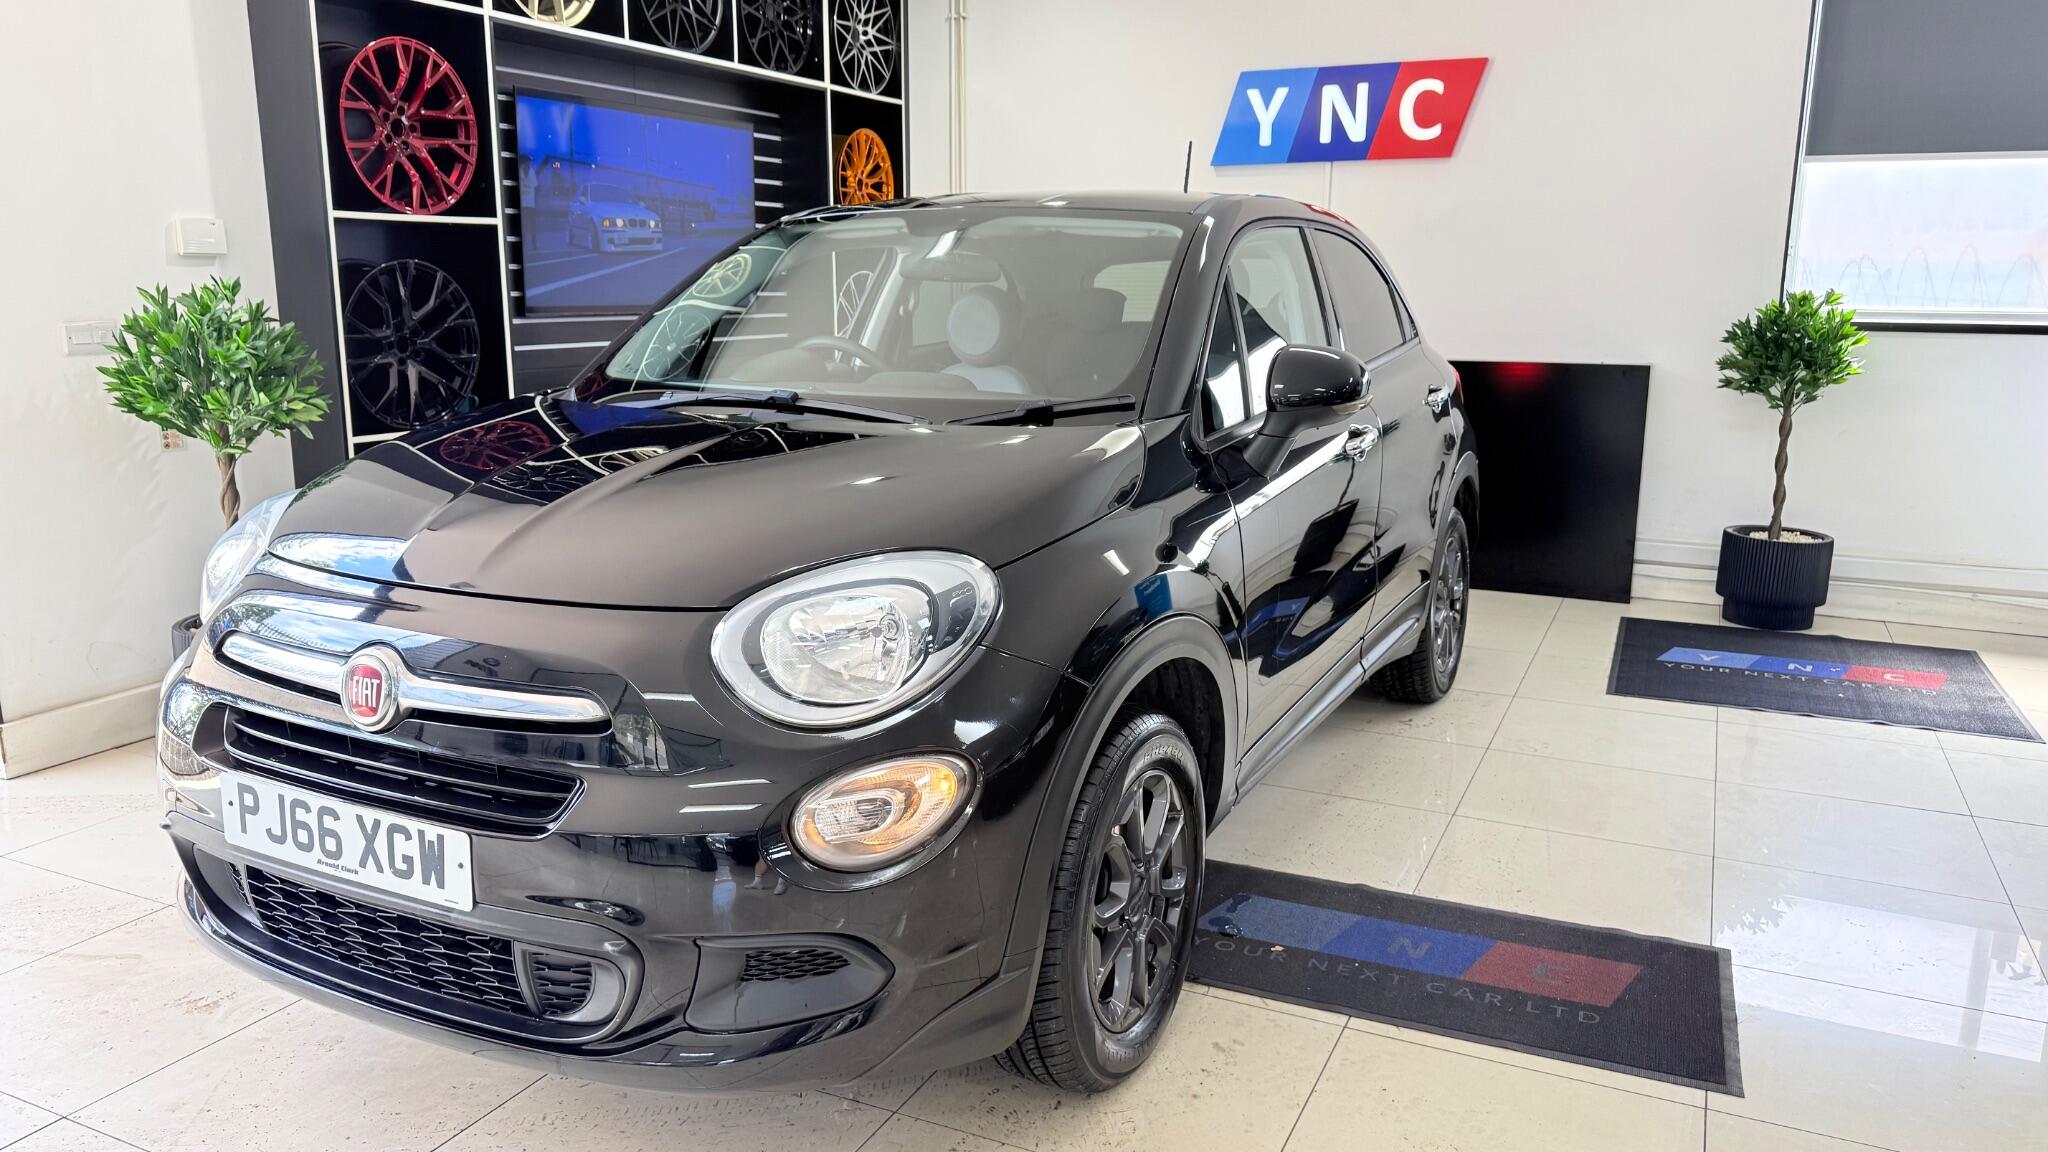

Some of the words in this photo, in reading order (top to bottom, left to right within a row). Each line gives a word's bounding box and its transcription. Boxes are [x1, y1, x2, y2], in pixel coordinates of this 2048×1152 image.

[1246, 78, 1445, 147] YNC
[352, 675, 381, 708] FIAT
[1663, 662, 1730, 673] YOUR
[1744, 670, 1810, 682] NEXT
[236, 782, 344, 862] PJ66
[355, 813, 446, 890] XGW
[1194, 936, 1288, 963] YOUR
[1307, 957, 1405, 985] NEXT
[1426, 982, 1503, 1007] CAR
[1526, 1000, 1601, 1025] LTD
